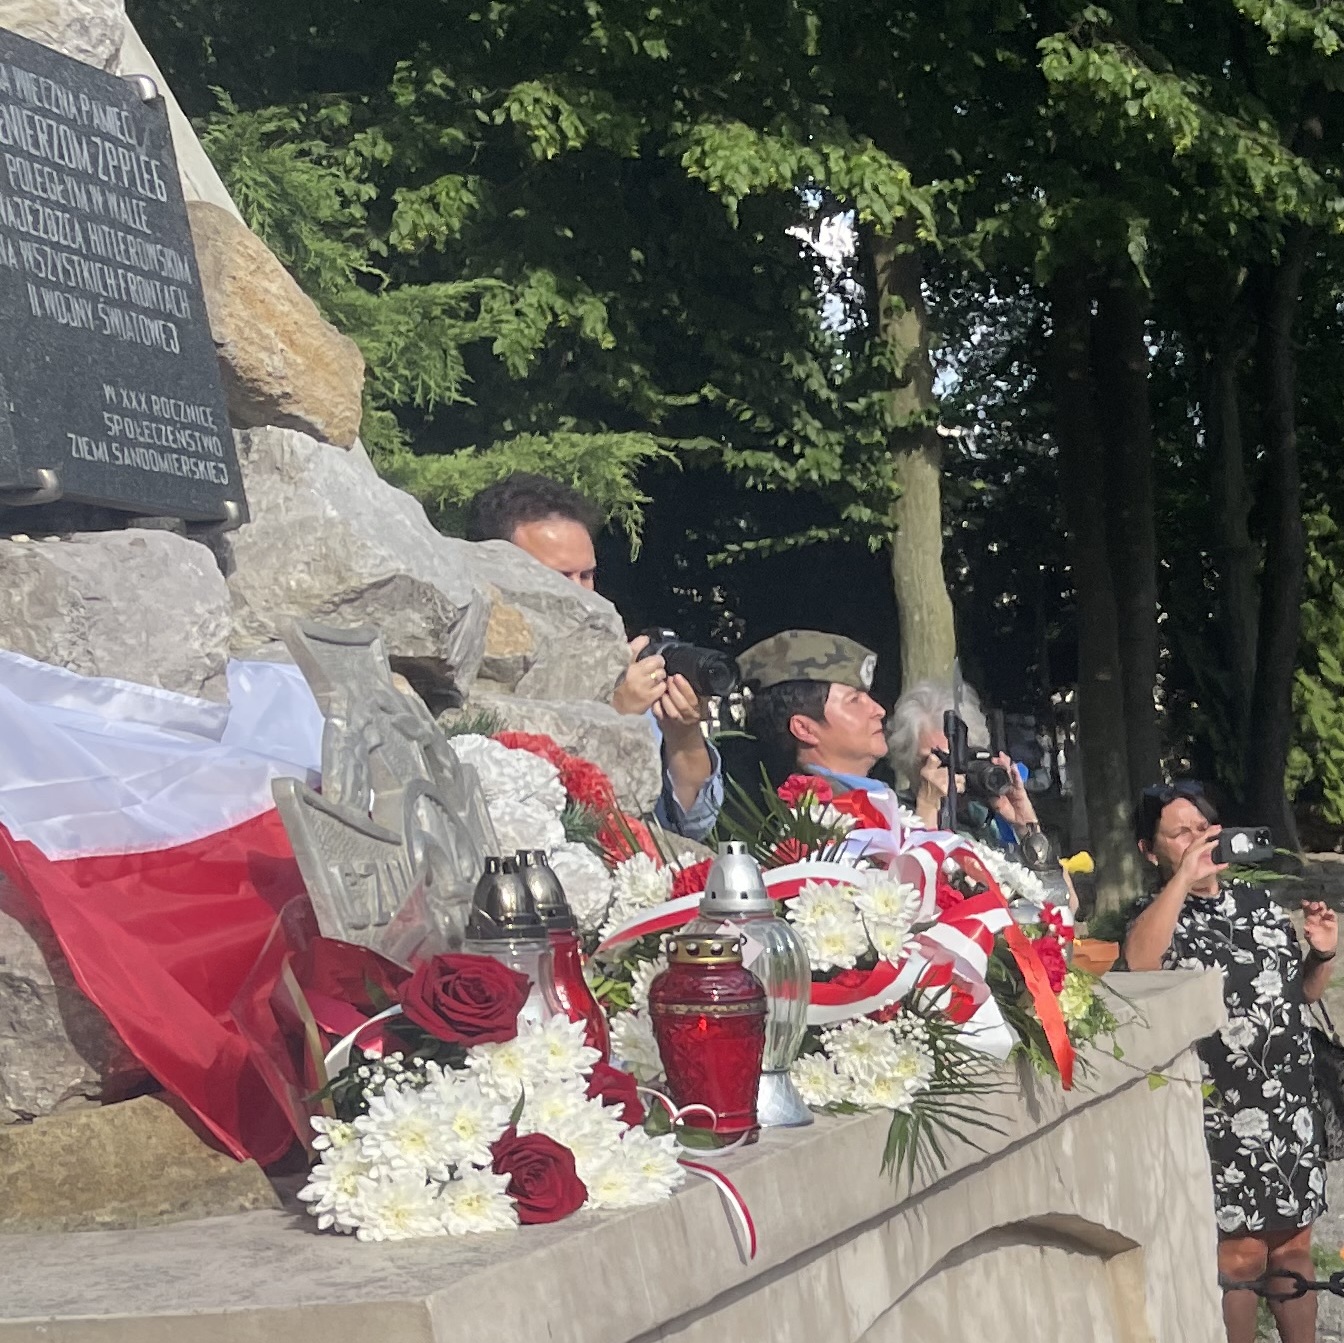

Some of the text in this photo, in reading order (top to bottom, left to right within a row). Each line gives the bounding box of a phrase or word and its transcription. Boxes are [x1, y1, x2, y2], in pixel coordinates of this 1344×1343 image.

[0, 103, 93, 175] NIERZOM
[5, 152, 90, 214] POLEGŁYM
[105, 190, 152, 234] WALCE
[19, 239, 119, 300] WSZYSTKICH
[117, 268, 192, 320] FRONTACH
[87, 220, 193, 285] HITLEROWSKIM
[40, 286, 95, 331] WOJNY
[97, 297, 181, 355] ŚWIATOWEJ
[103, 383, 218, 433] W XXX ROCZNICĘ
[103, 411, 224, 458] SPOŁECZEŃSTWO
[67, 432, 229, 485] ZIEMI SANDOMIERSKIEJ
